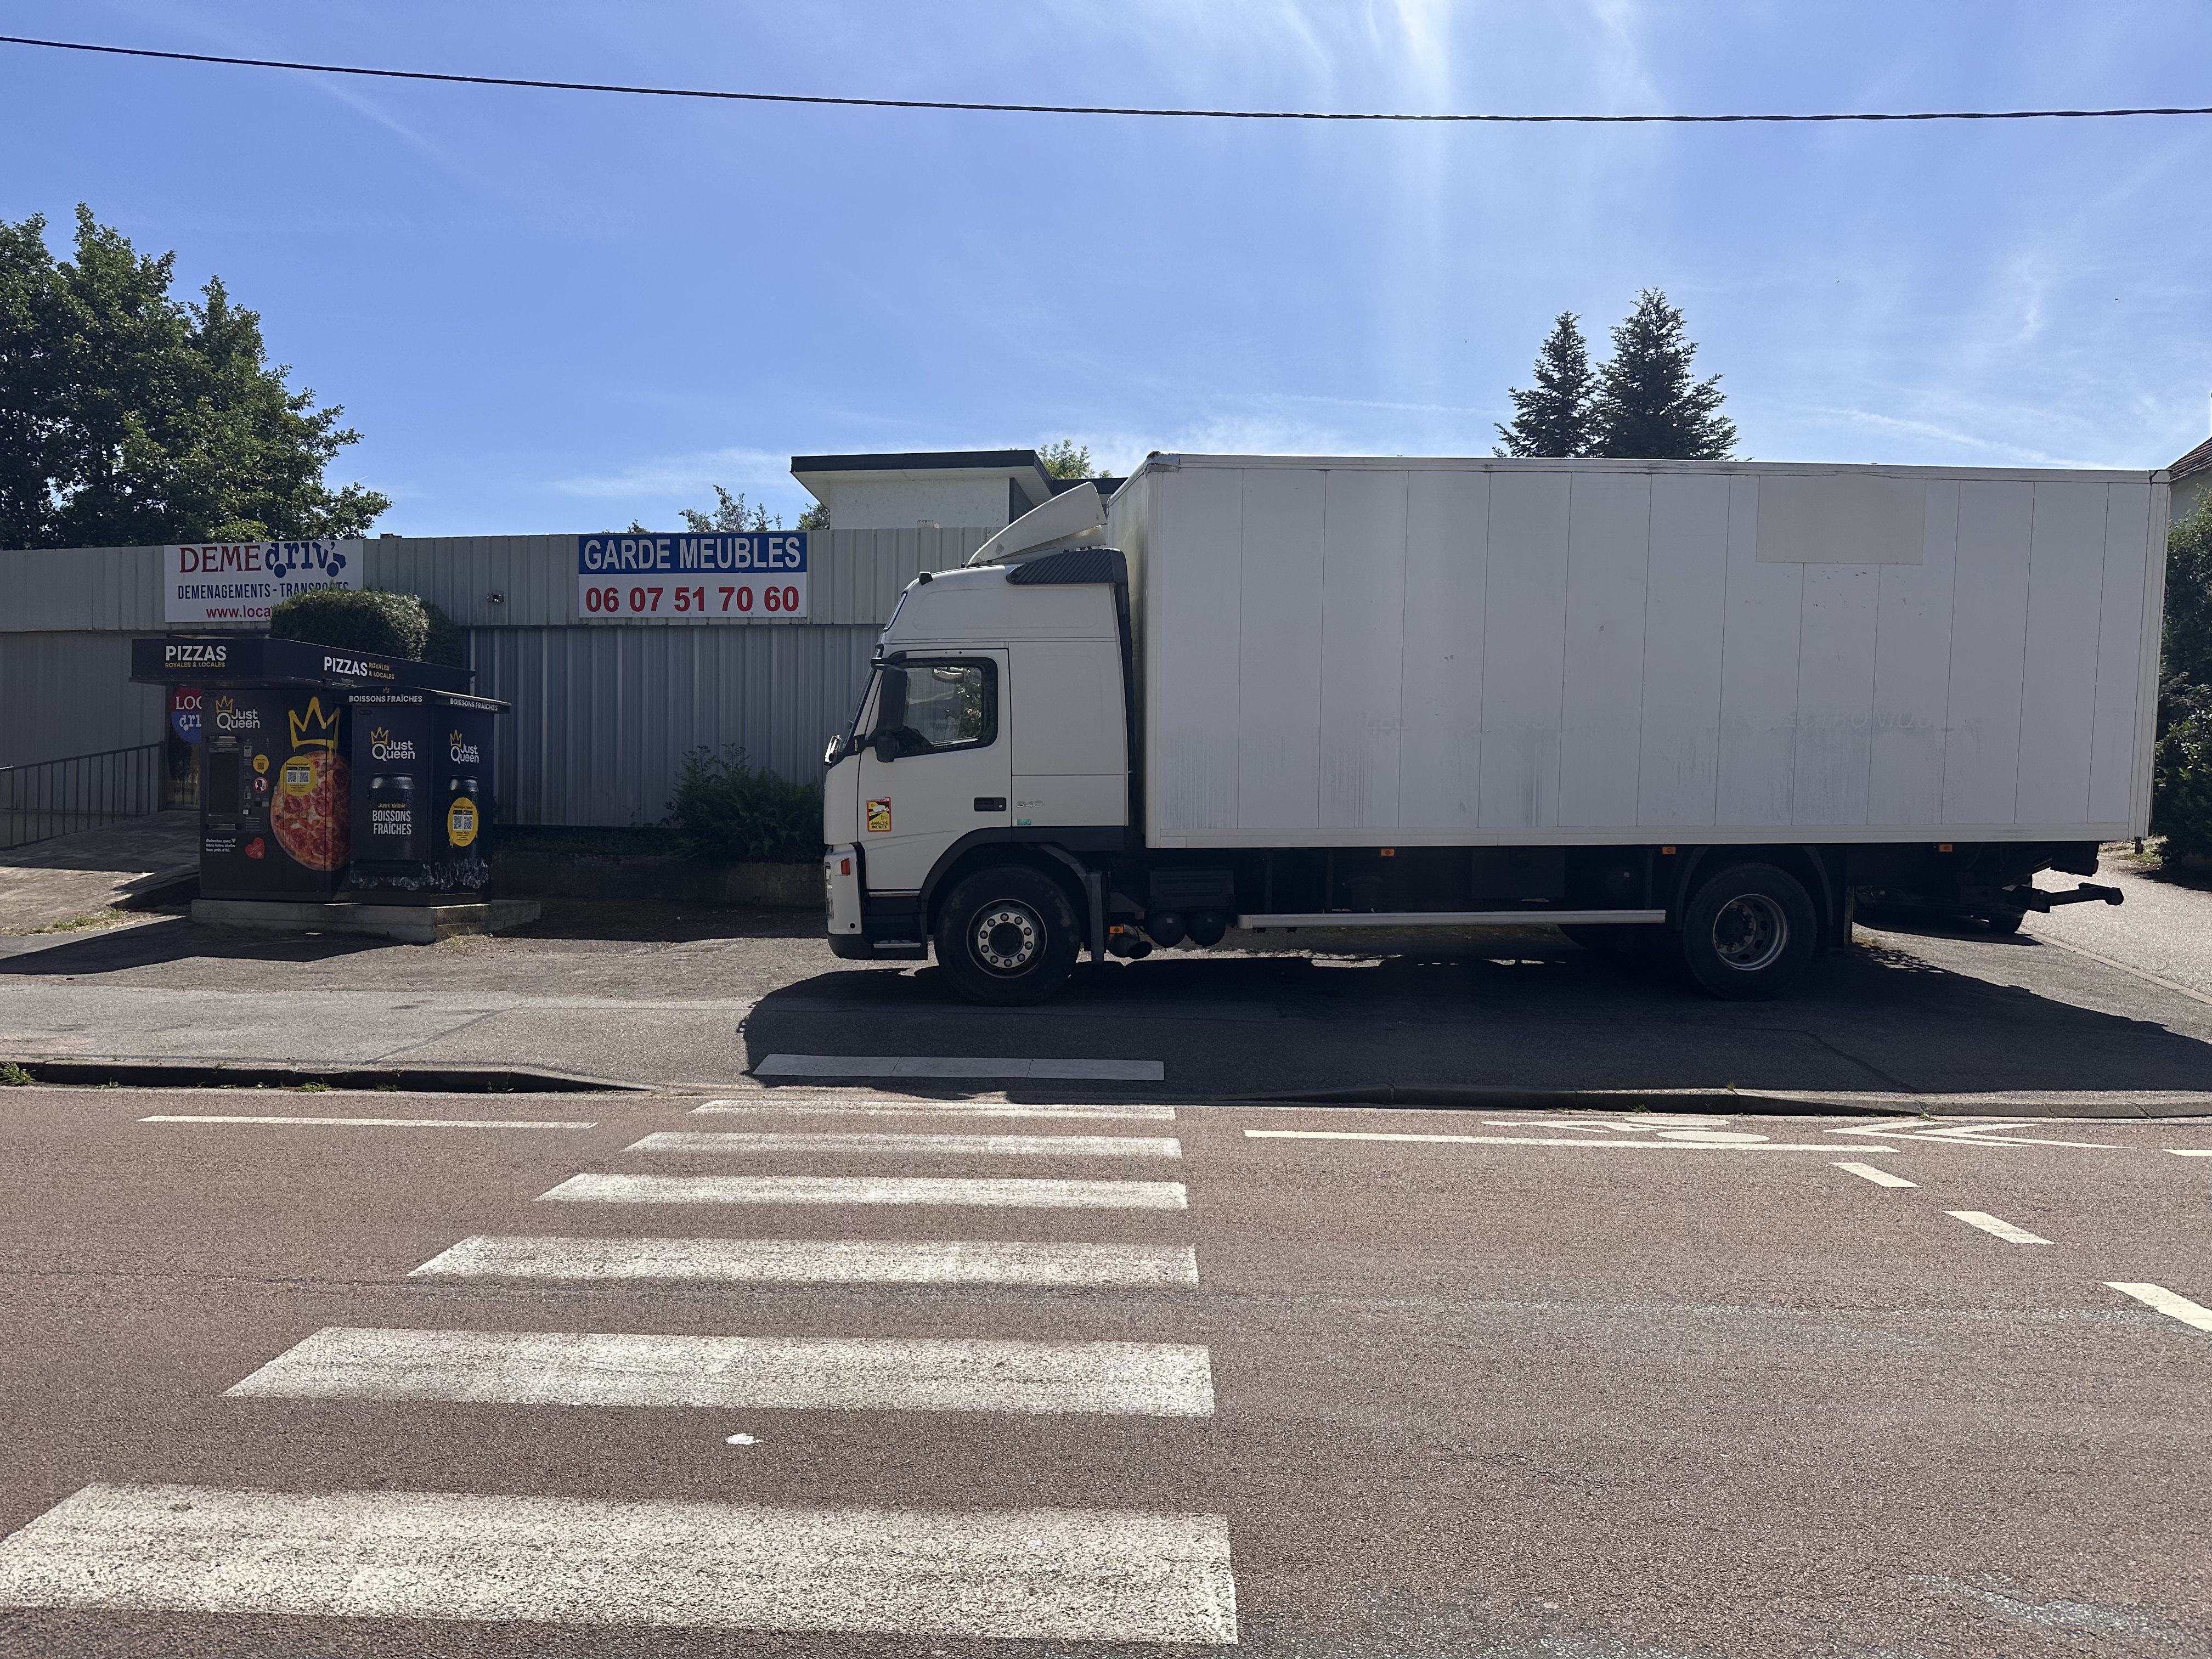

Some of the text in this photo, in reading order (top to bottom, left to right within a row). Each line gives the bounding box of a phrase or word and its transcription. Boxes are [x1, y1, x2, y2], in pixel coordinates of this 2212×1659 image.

[584, 537, 800, 569] GARDE MEUBLES
[178, 583, 270, 600] DEMENAGEMENTS
[279, 582, 349, 597] TRANSPOTS
[585, 586, 799, 612] 06 07 51 70 60
[206, 605, 271, 618] www.loca
[166, 645, 227, 661] PIZZAS
[324, 656, 368, 676] PIZZAS
[369, 662, 390, 671] ROYALES
[374, 672, 394, 680] LOCALES
[387, 693, 423, 702] FRAÎCHES
[449, 698, 475, 708] BOISSONS
[231, 709, 258, 720] Just
[216, 712, 260, 731] Queen
[371, 743, 415, 761] Queen
[386, 740, 413, 751] Just
[460, 743, 478, 754] Just
[450, 746, 479, 764] Queen
[372, 810, 411, 822] BOISSONS
[373, 821, 412, 835] FRAÎCHES
